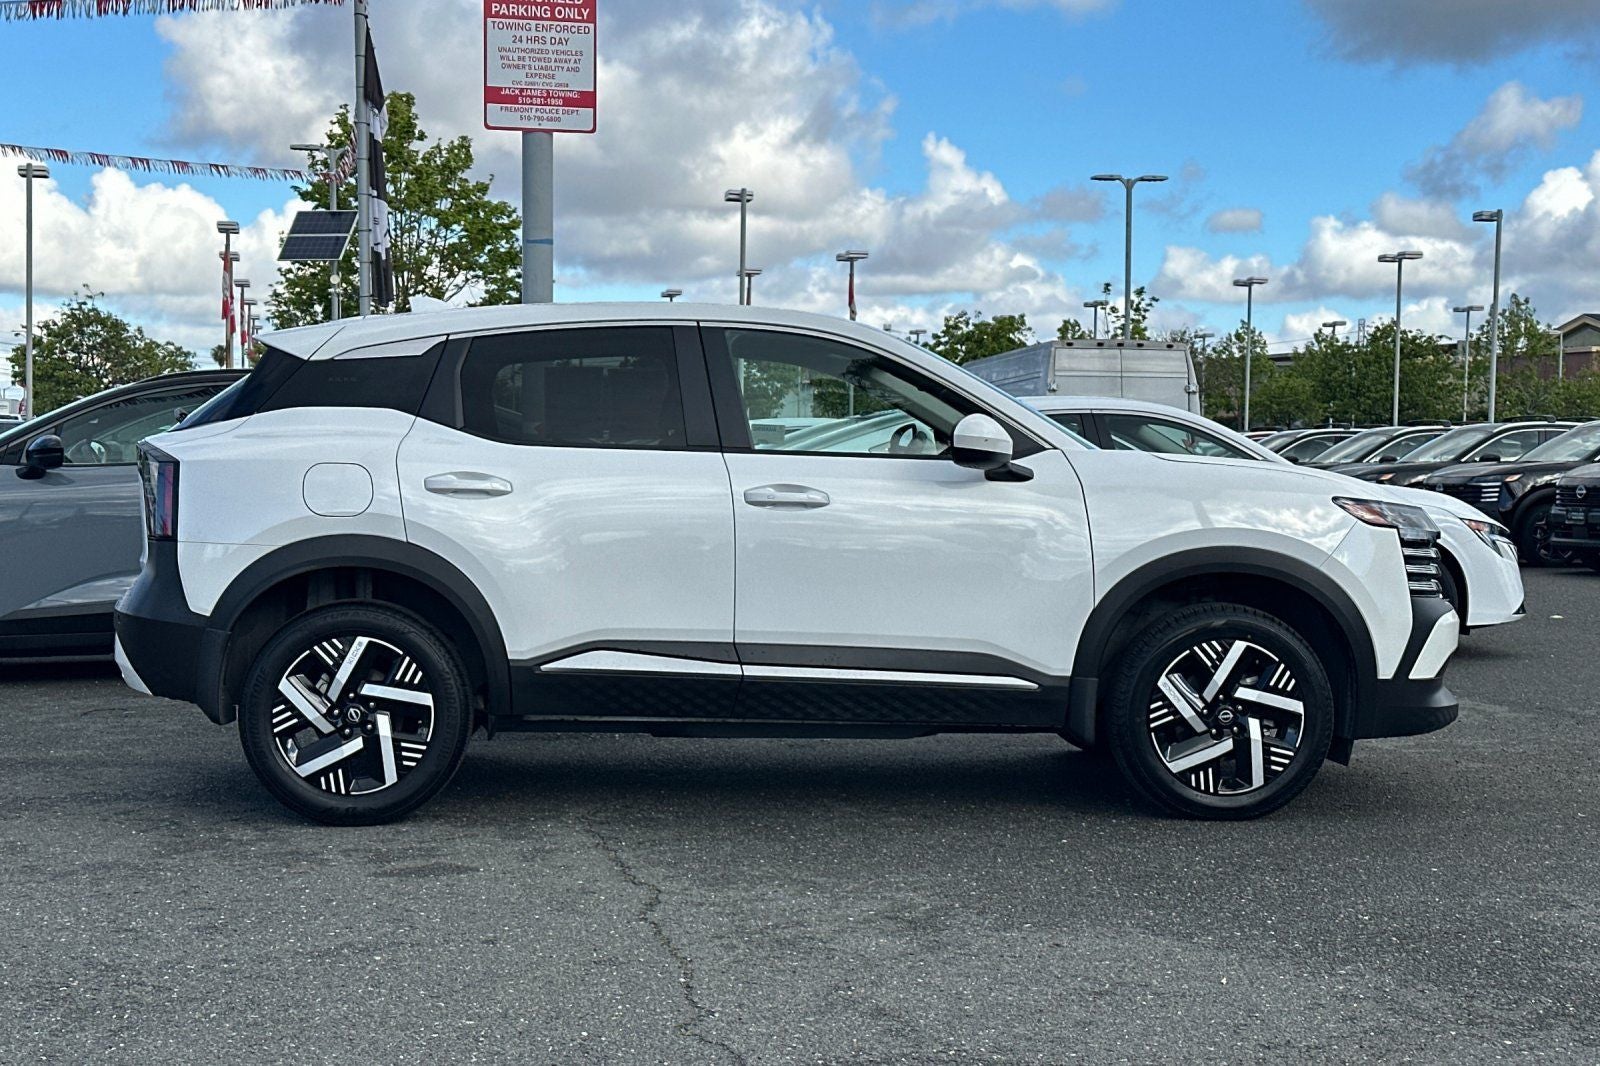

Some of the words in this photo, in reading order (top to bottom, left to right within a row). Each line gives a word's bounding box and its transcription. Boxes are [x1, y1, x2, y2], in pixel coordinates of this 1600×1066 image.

[491, 3, 551, 18] PARKING
[555, 7, 590, 20] ONLY
[491, 21, 532, 31] TOWING
[535, 24, 590, 35] ENFORCED
[512, 35, 523, 44] 24
[526, 36, 547, 45] HRS
[550, 37, 570, 46] DAY
[498, 47, 550, 55] UNAUTHORIZED
[533, 64, 565, 72] LIABILITY
[500, 87, 520, 96] JACK
[521, 88, 547, 97] JAMES
[548, 90, 581, 98] TOWING:
[535, 107, 561, 115] POLICE
